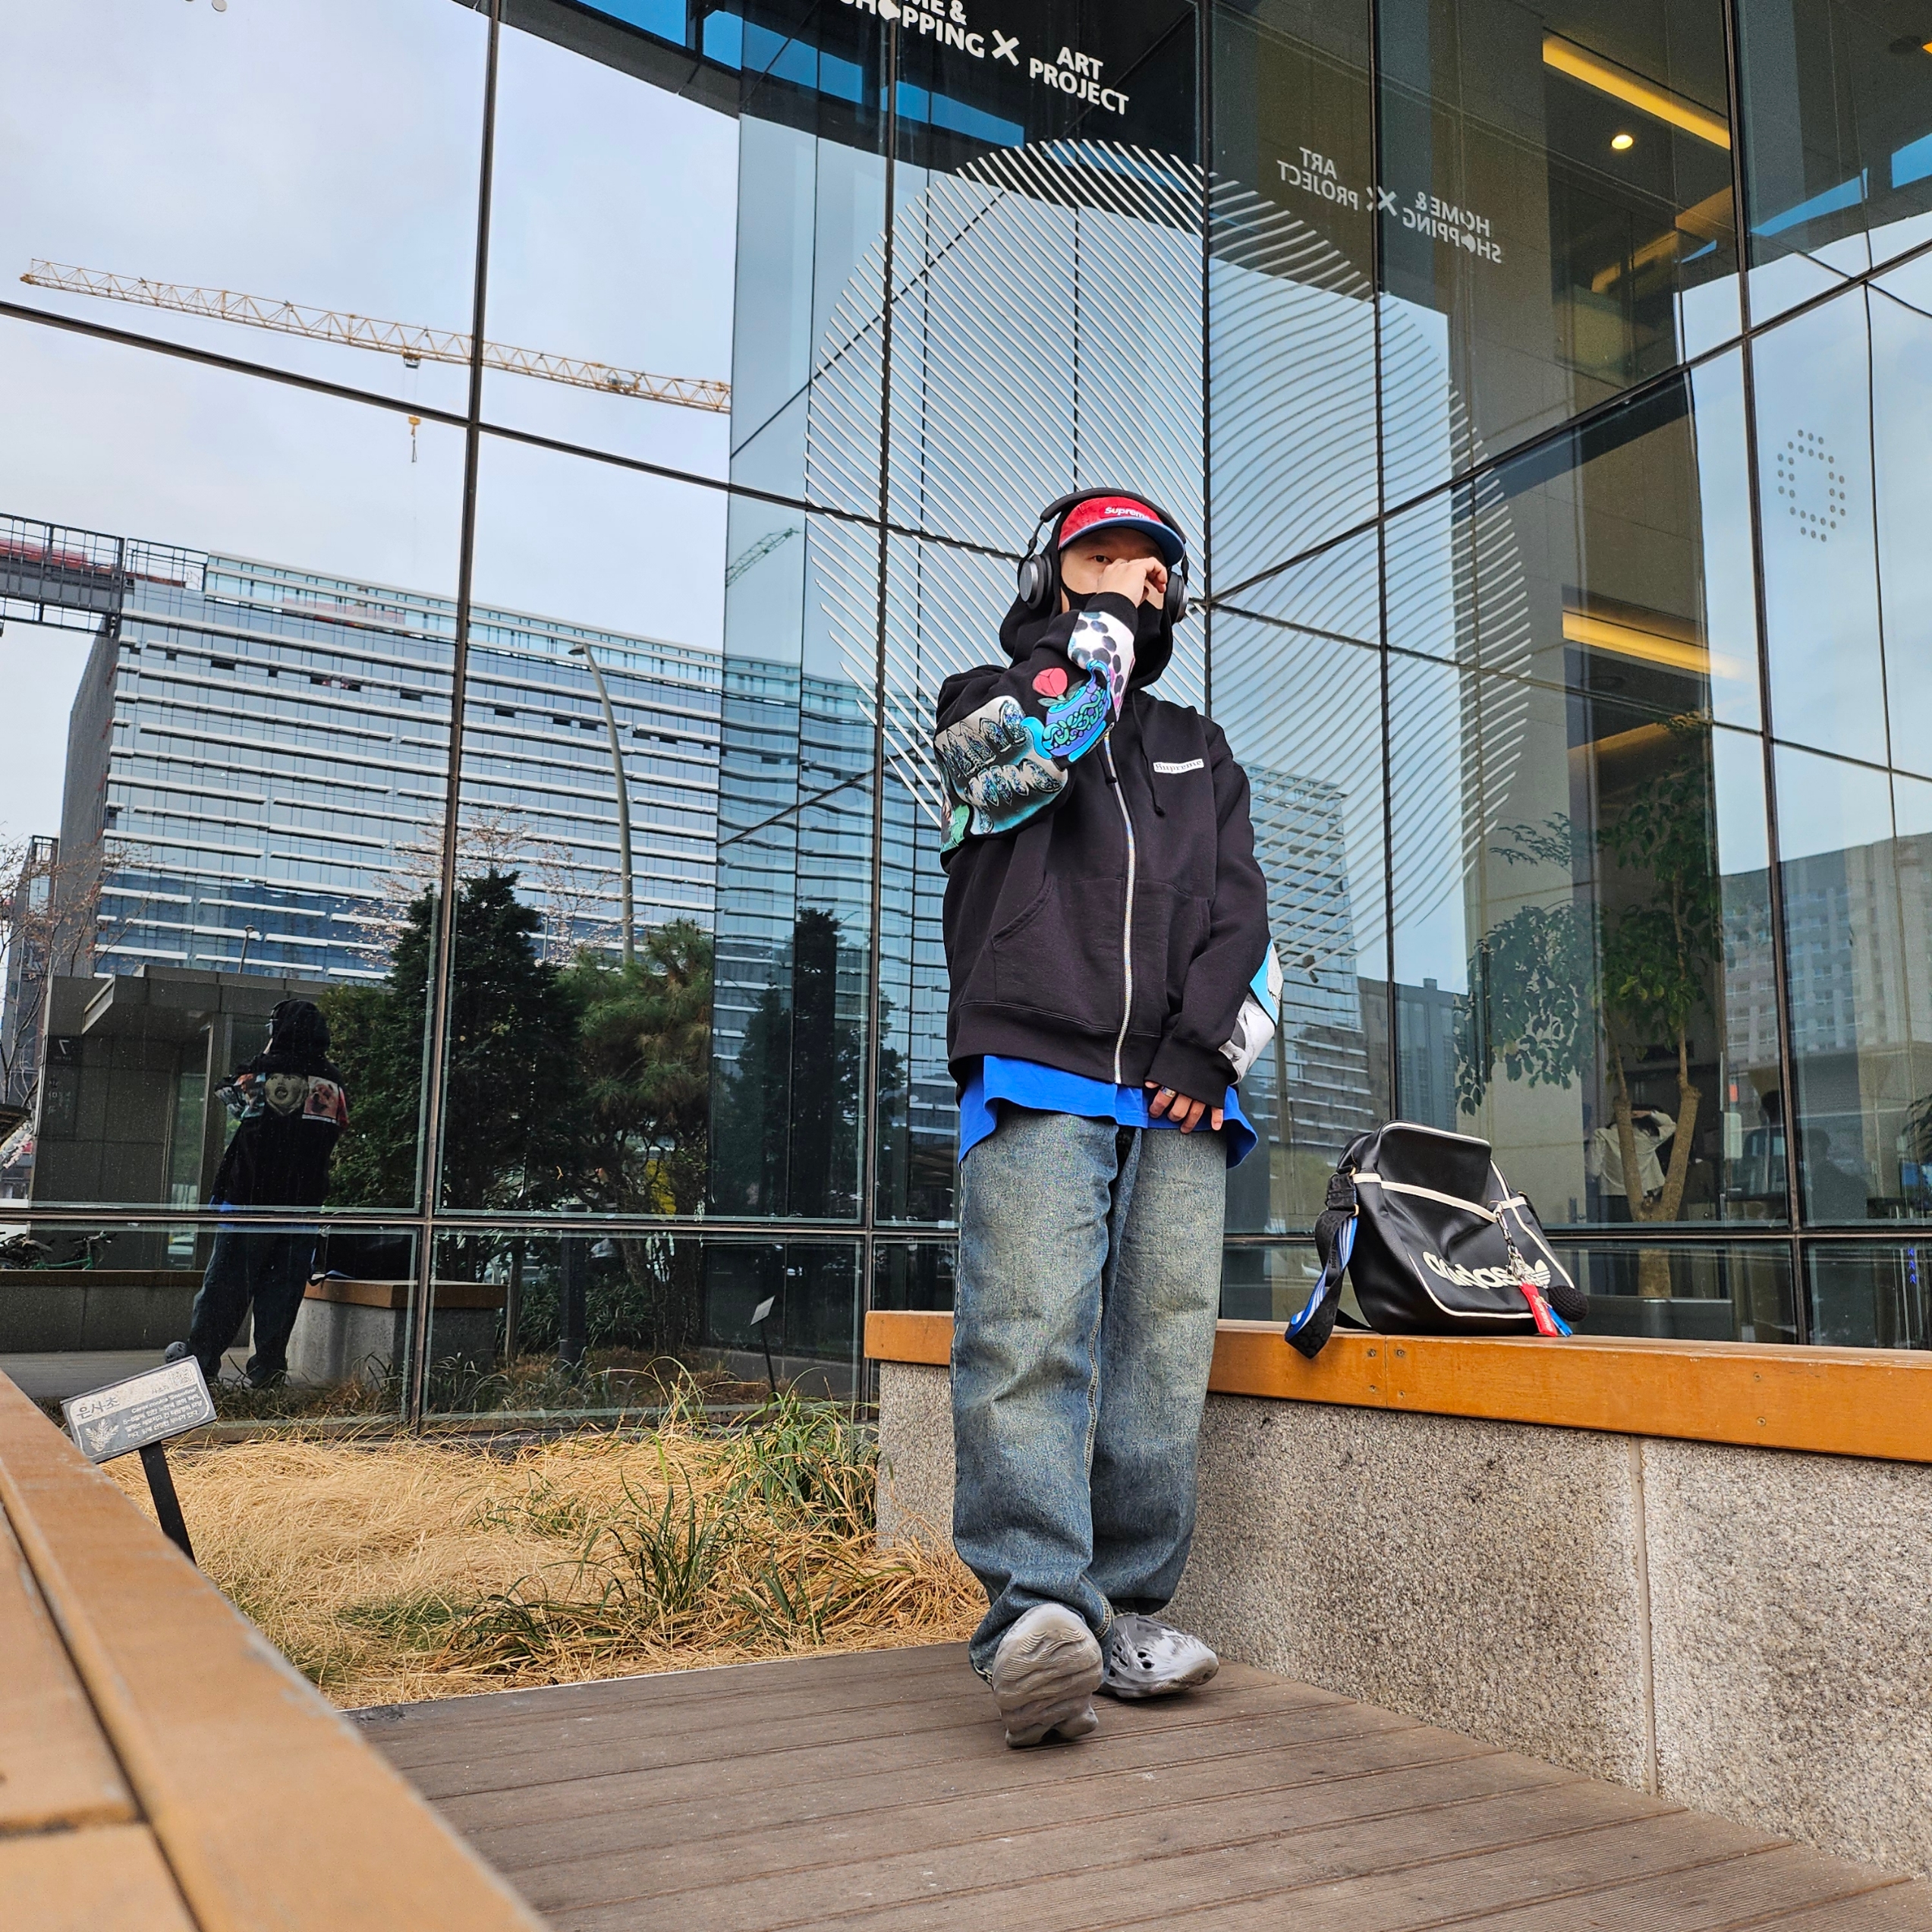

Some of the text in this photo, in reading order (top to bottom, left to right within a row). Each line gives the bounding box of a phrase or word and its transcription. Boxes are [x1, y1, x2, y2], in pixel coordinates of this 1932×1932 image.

[1056, 46, 1103, 80] ART
[1029, 58, 1129, 115] PROJECT
[74, 1395, 121, 1421] 은사초
